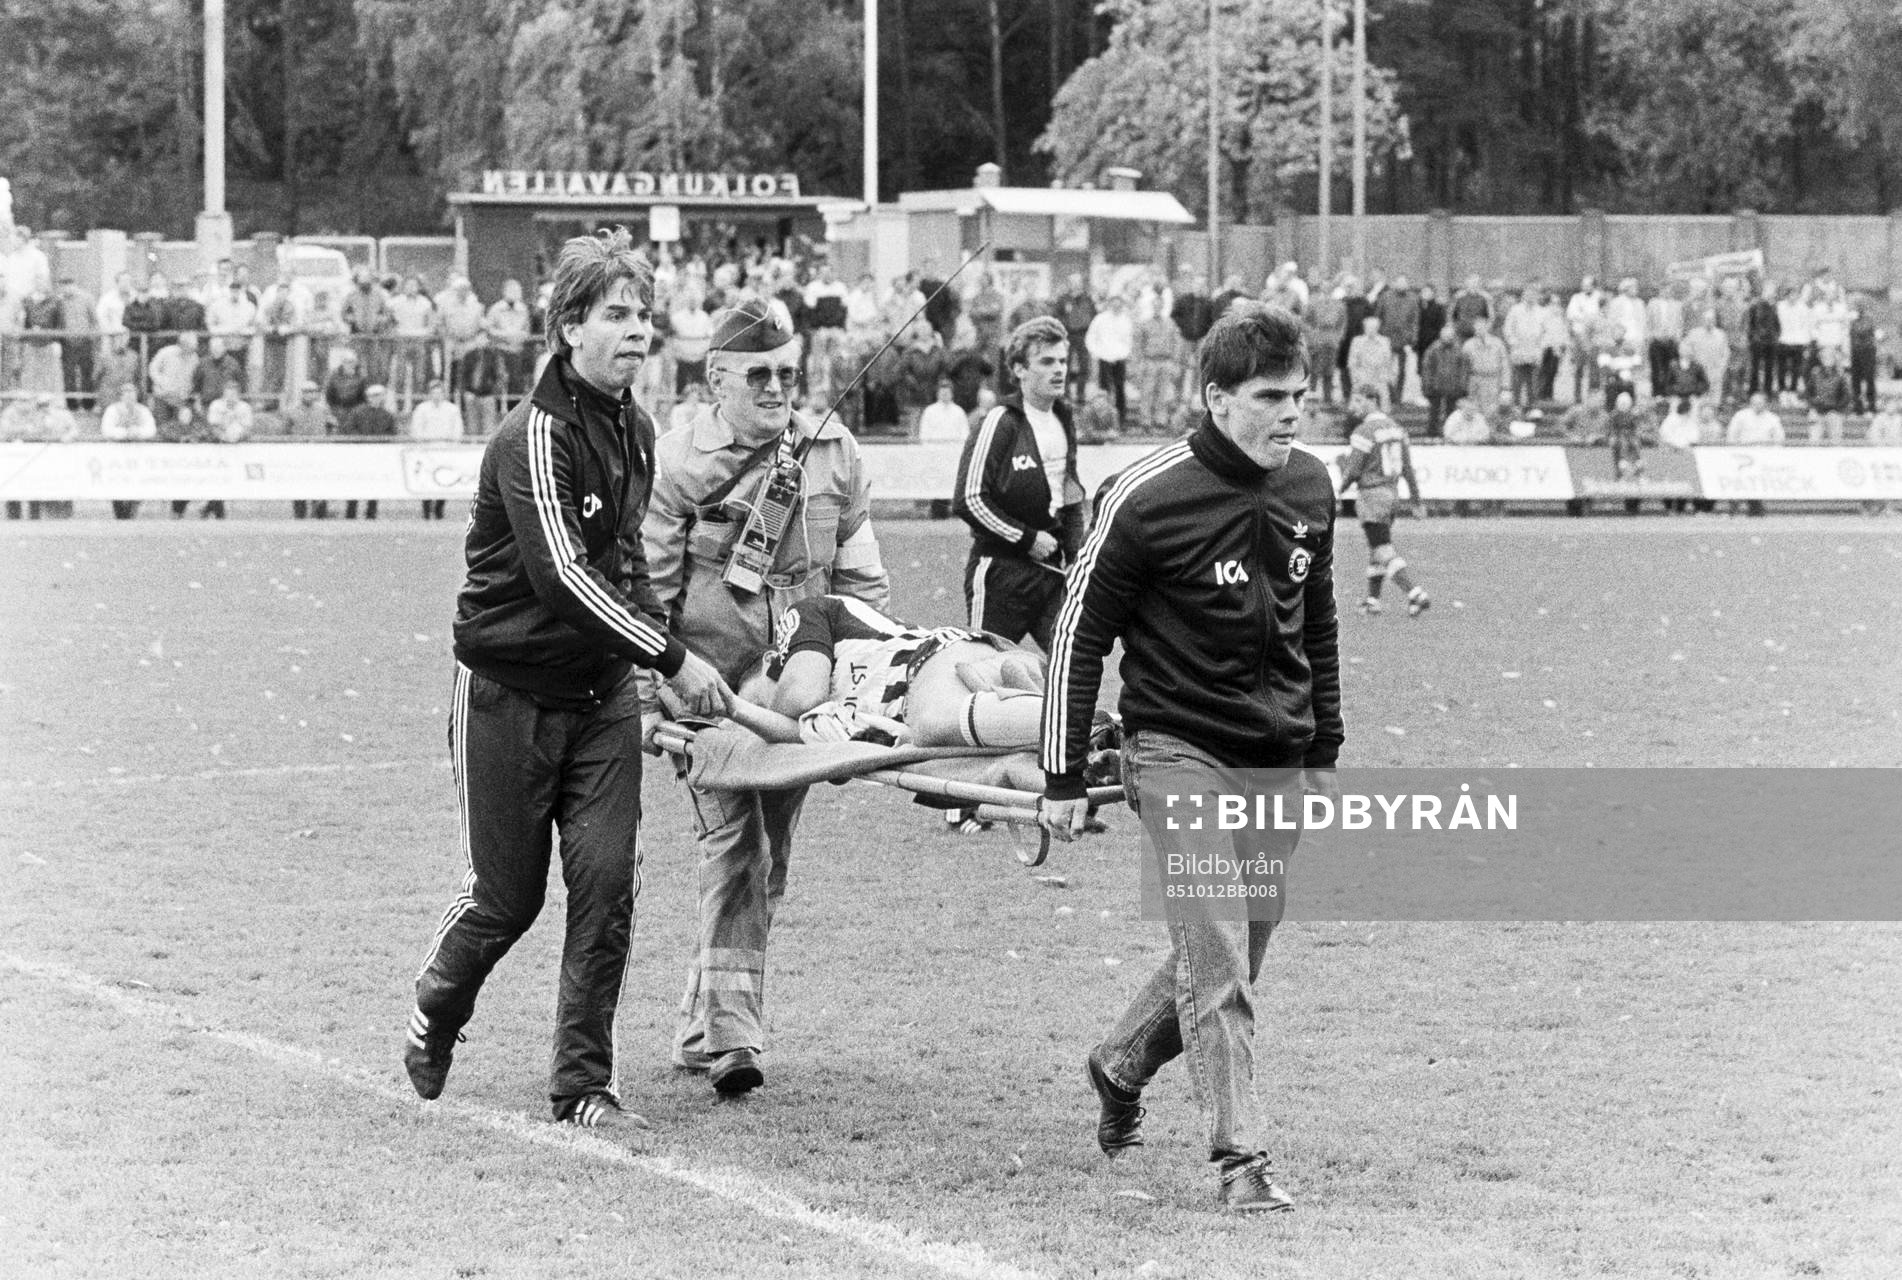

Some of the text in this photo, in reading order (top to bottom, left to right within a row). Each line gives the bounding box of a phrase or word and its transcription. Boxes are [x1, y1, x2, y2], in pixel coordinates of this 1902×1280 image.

[1012, 455, 1037, 471] ICA
[1444, 465, 1511, 485] RADIO
[1521, 465, 1550, 484] TV
[1214, 560, 1249, 585] ICA
